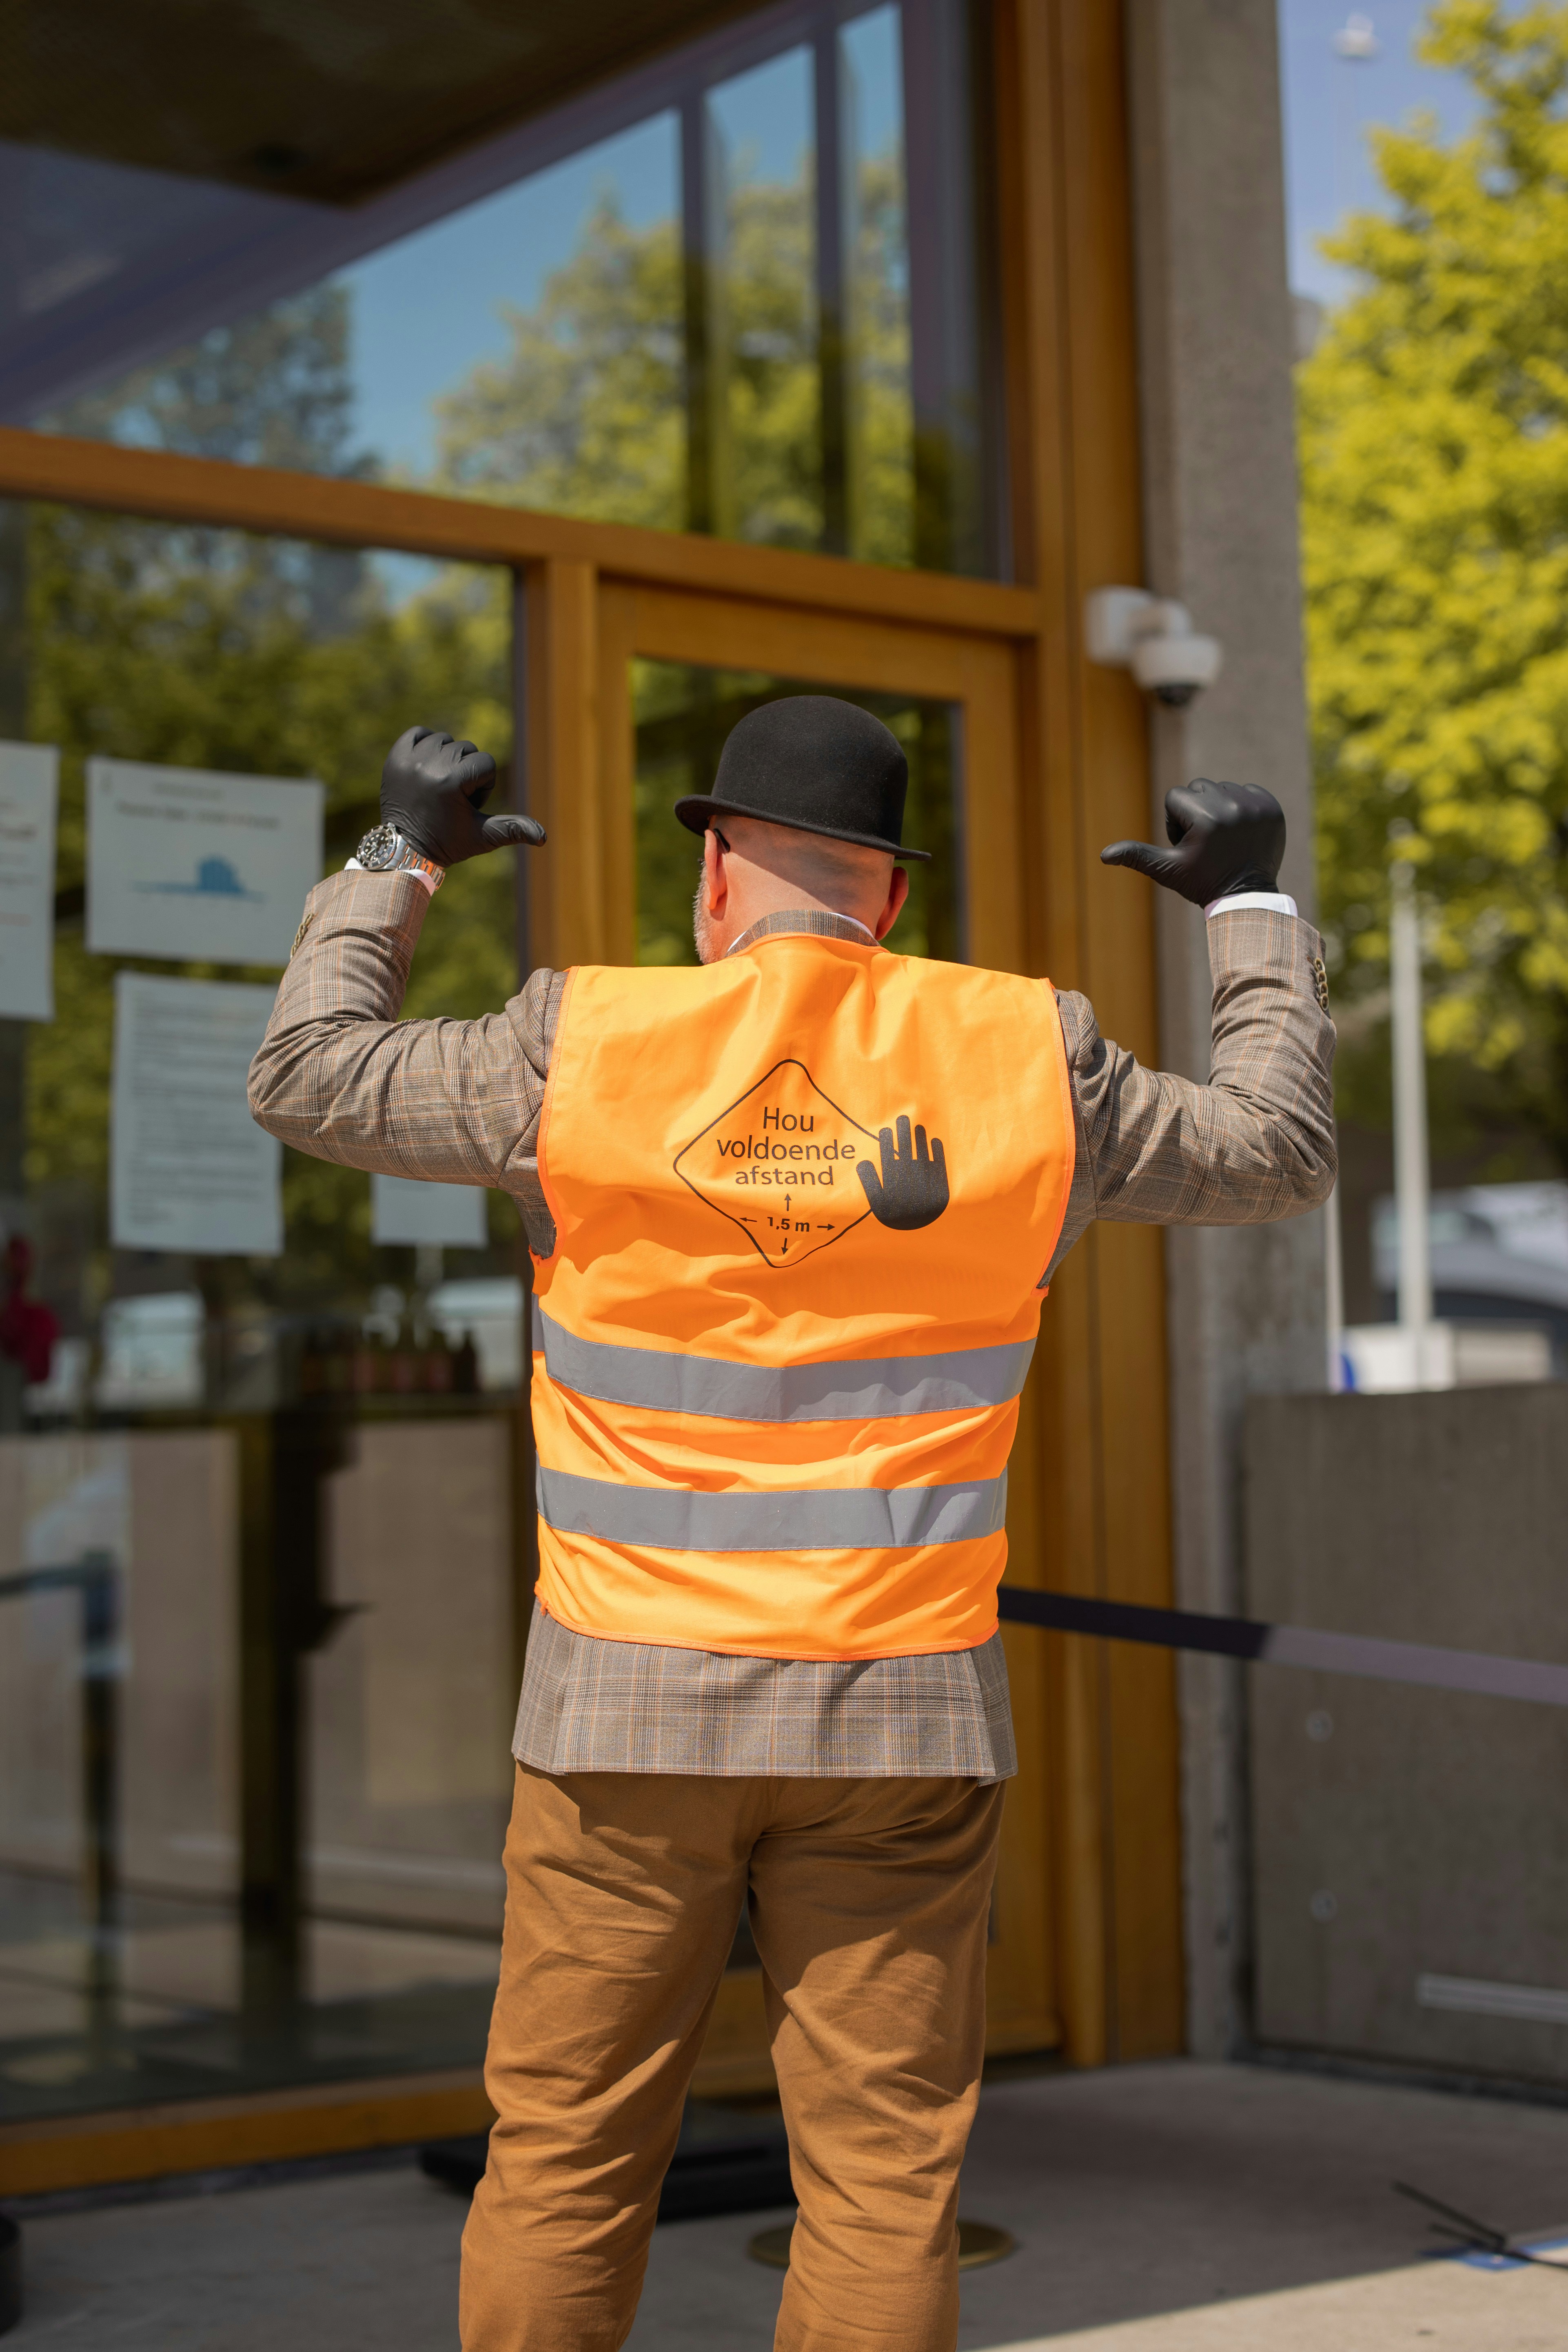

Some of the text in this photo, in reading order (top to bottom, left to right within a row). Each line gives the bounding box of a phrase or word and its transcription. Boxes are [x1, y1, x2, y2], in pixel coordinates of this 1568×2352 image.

[763, 1106, 814, 1132] Hou
[716, 1134, 856, 1160] voldoende
[735, 1165, 834, 1185] afstand
[767, 1216, 810, 1232] 1,5 m
